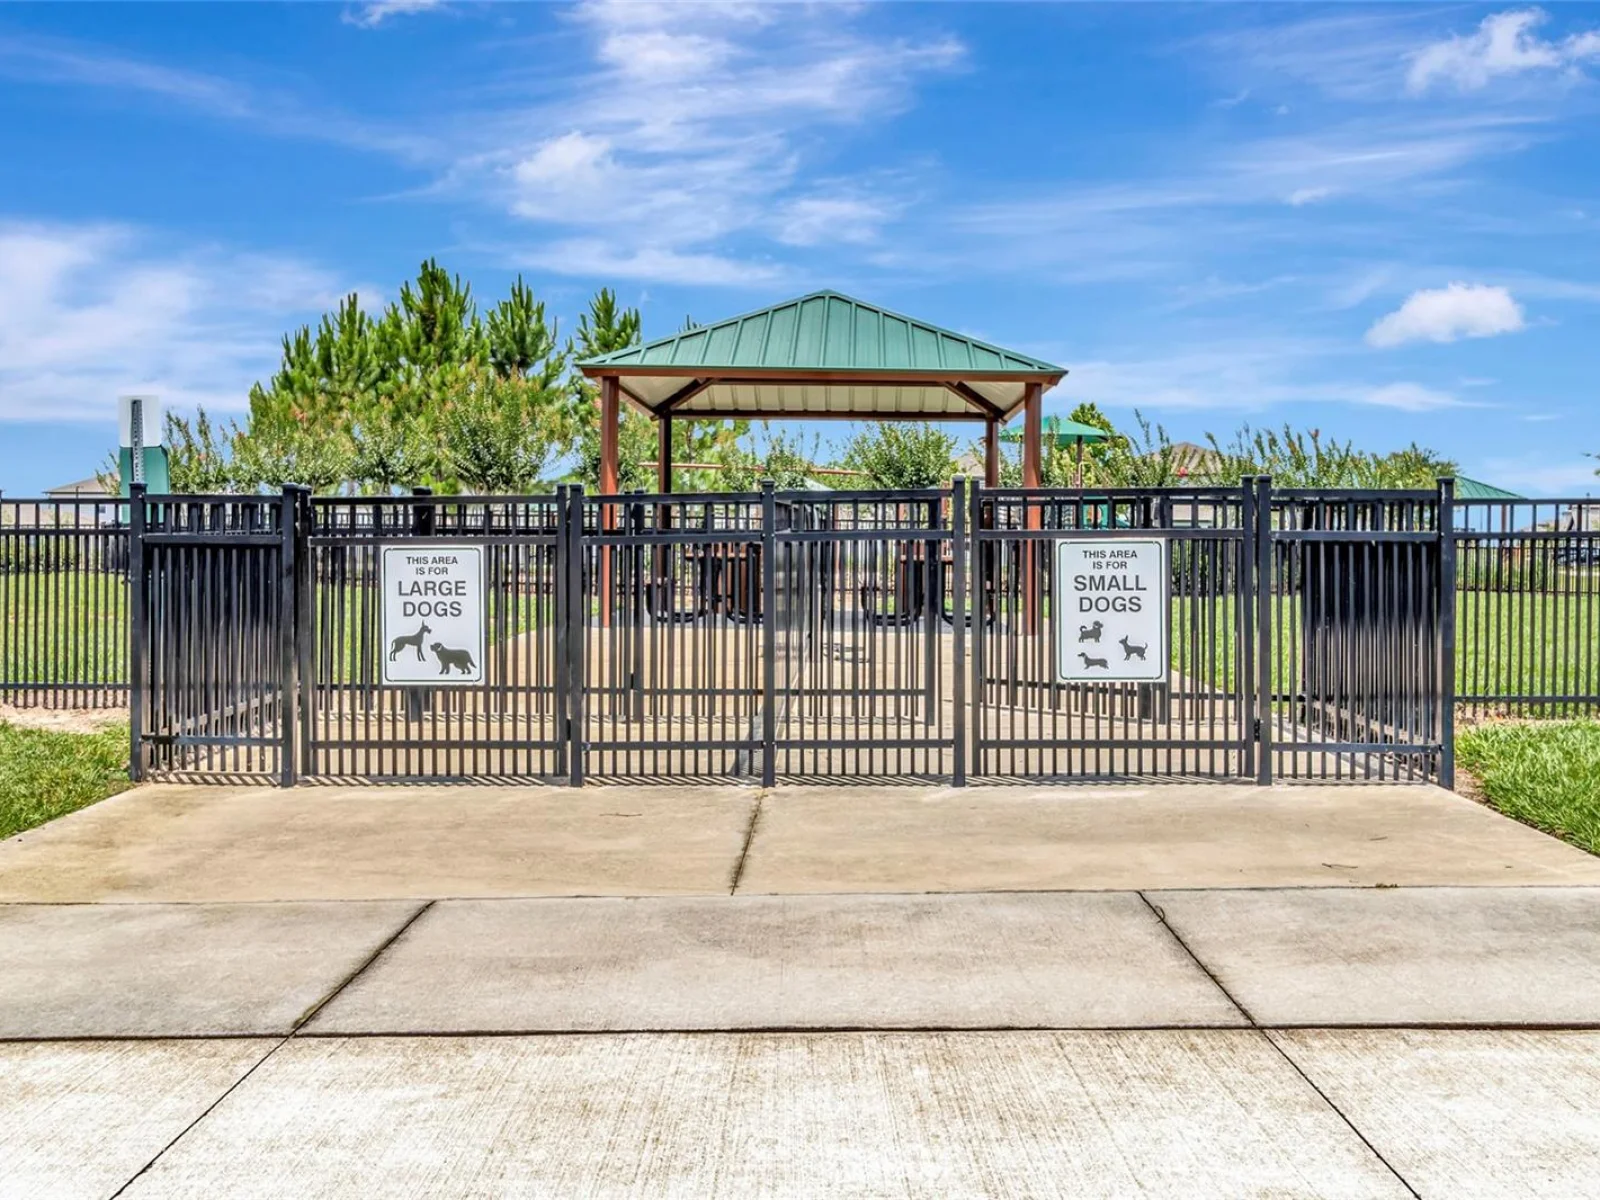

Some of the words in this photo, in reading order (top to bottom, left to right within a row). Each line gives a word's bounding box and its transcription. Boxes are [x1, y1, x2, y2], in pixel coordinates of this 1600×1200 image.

[406, 556, 429, 565] THIS
[431, 556, 458, 565] AREA
[1082, 550, 1107, 559] THIS
[1109, 550, 1138, 559] AREA
[415, 567, 425, 575] IS
[428, 567, 449, 575] FOR
[1092, 561, 1103, 569] IS
[1105, 561, 1128, 569] FOR
[398, 580, 467, 596] LARGE
[1073, 575, 1147, 592] SMALL
[403, 601, 462, 617] DOGS
[1079, 596, 1142, 613] DOGS
